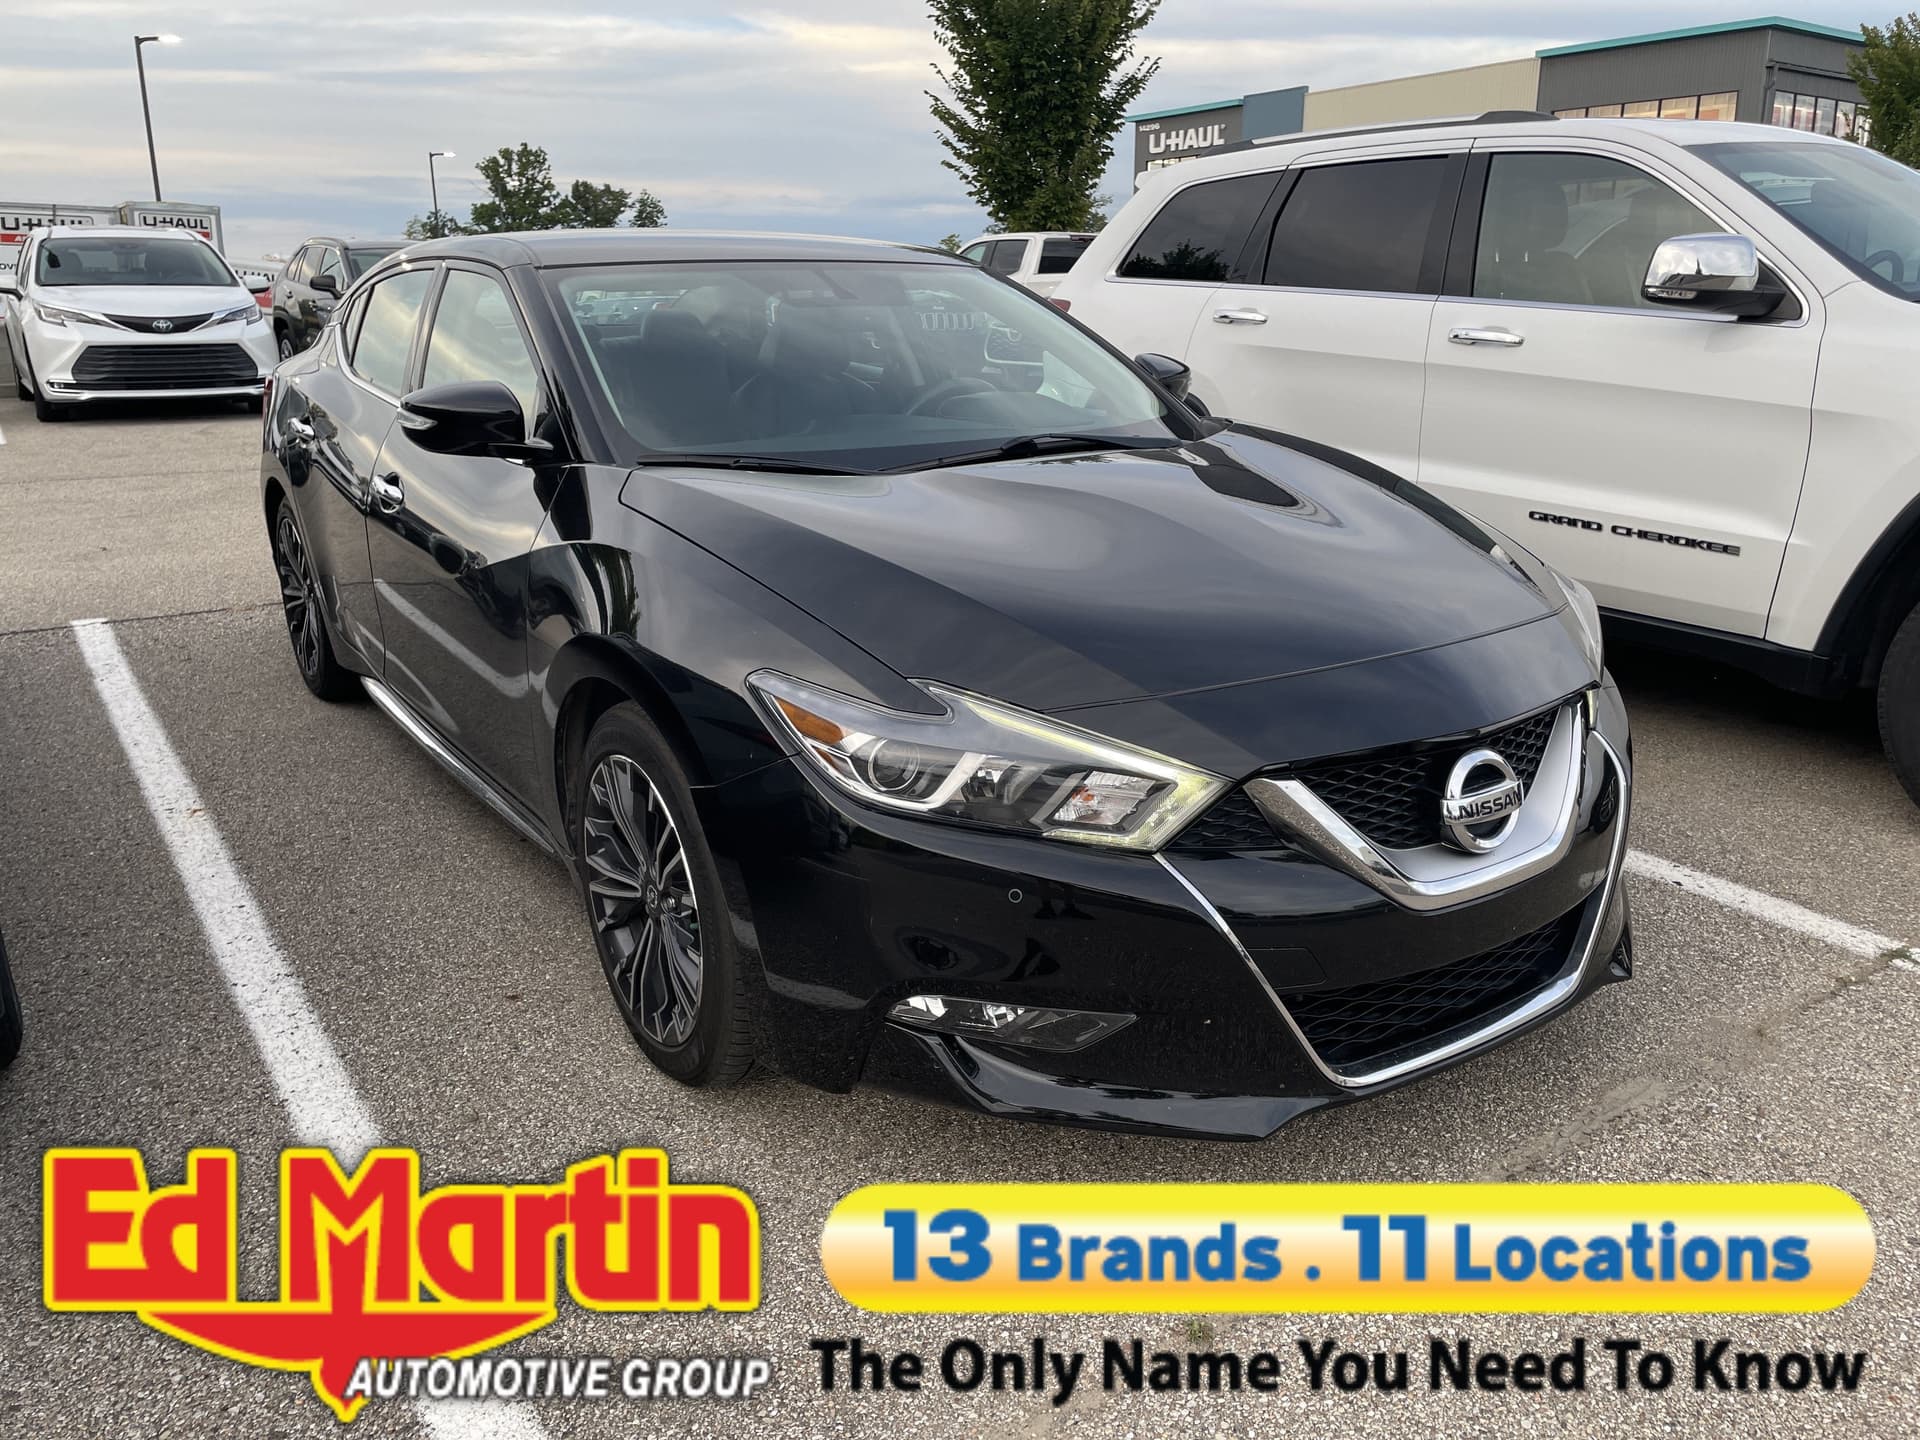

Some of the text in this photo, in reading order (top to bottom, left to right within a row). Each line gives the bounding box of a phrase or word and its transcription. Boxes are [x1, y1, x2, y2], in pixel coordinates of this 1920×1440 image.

[1149, 125, 1225, 154] U-HAUL
[143, 216, 208, 229] U-HAUL
[1528, 510, 1741, 556] GRAND CHEROKEE
[1459, 783, 1521, 819] NISSAN
